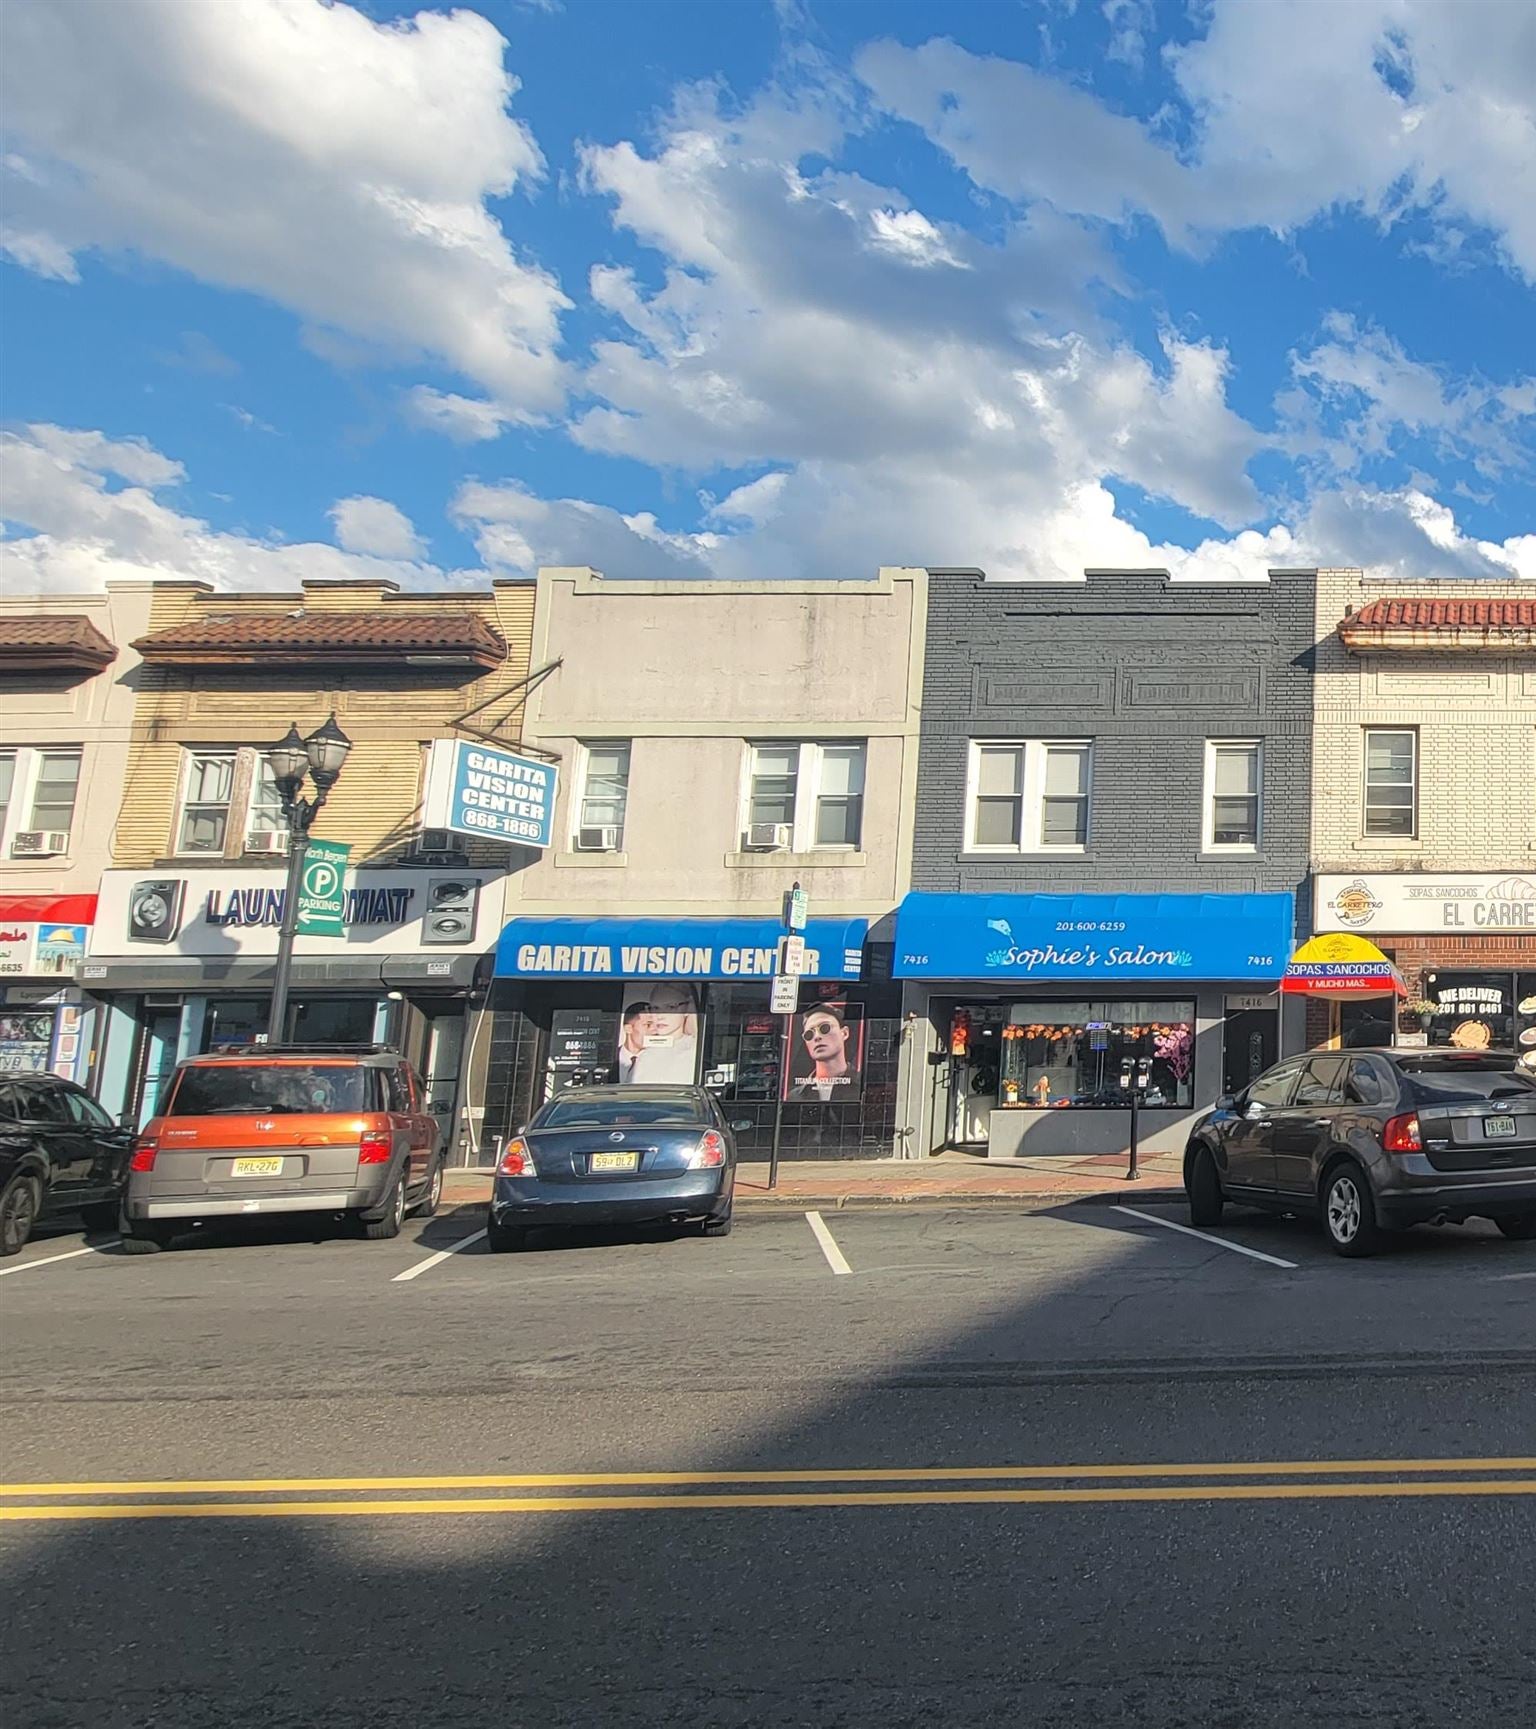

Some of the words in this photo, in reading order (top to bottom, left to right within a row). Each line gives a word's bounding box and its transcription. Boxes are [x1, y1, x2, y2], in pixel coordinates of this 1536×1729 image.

[467, 752, 546, 786] GARITA
[467, 770, 544, 802] VISION
[462, 788, 545, 820] CENTER
[465, 810, 539, 837] 868-1886
[314, 869, 332, 894] P
[1435, 887, 1477, 898] SANCOCHOS
[299, 897, 341, 912] PARKING
[1443, 902, 1465, 926] EL
[1055, 921, 1126, 932] 201-600-6259
[518, 945, 612, 973] GARITA
[621, 946, 712, 974] VISION
[903, 955, 929, 965] 7416
[1003, 944, 1100, 971] Sophie's
[1104, 945, 1176, 967] Salon
[1247, 955, 1273, 966] 7416
[1326, 964, 1391, 975] SANCOCHOS
[1307, 980, 1314, 988] Y
[1315, 980, 1345, 988] MUCHO
[1438, 988, 1458, 1003] WE
[1458, 987, 1503, 1003] DELIVER
[1438, 1003, 1455, 1014] 201
